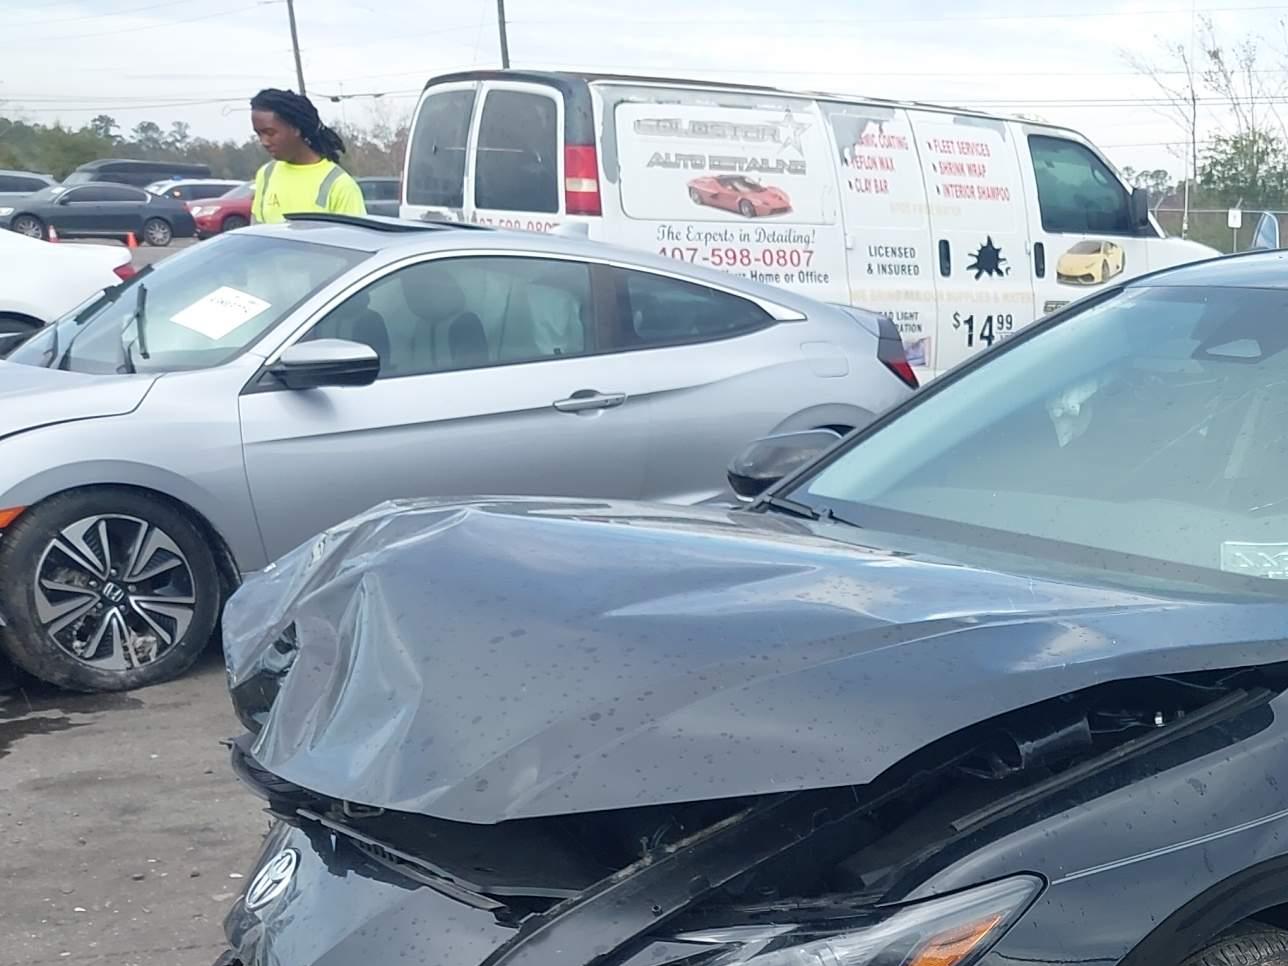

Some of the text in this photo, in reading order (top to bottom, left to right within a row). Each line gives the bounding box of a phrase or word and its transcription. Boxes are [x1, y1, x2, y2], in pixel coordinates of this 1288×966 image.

[879, 134, 909, 150] COATING
[933, 139, 991, 157] FLEET SERVICES
[647, 152, 706, 170] AUTO
[879, 157, 895, 171] WAX
[938, 161, 987, 178] SHRINK WRAP
[854, 178, 889, 193] CLAY BAR
[943, 184, 1010, 201] INTERIOR SHAMPOO
[656, 224, 816, 249] The Experts in Detailing!
[868, 245, 916, 259] LICENSED
[867, 263, 920, 276] & INSURED
[750, 271, 780, 283] Home
[784, 274, 795, 283] or
[798, 271, 830, 284] Office
[897, 312, 919, 321] LIGHT
